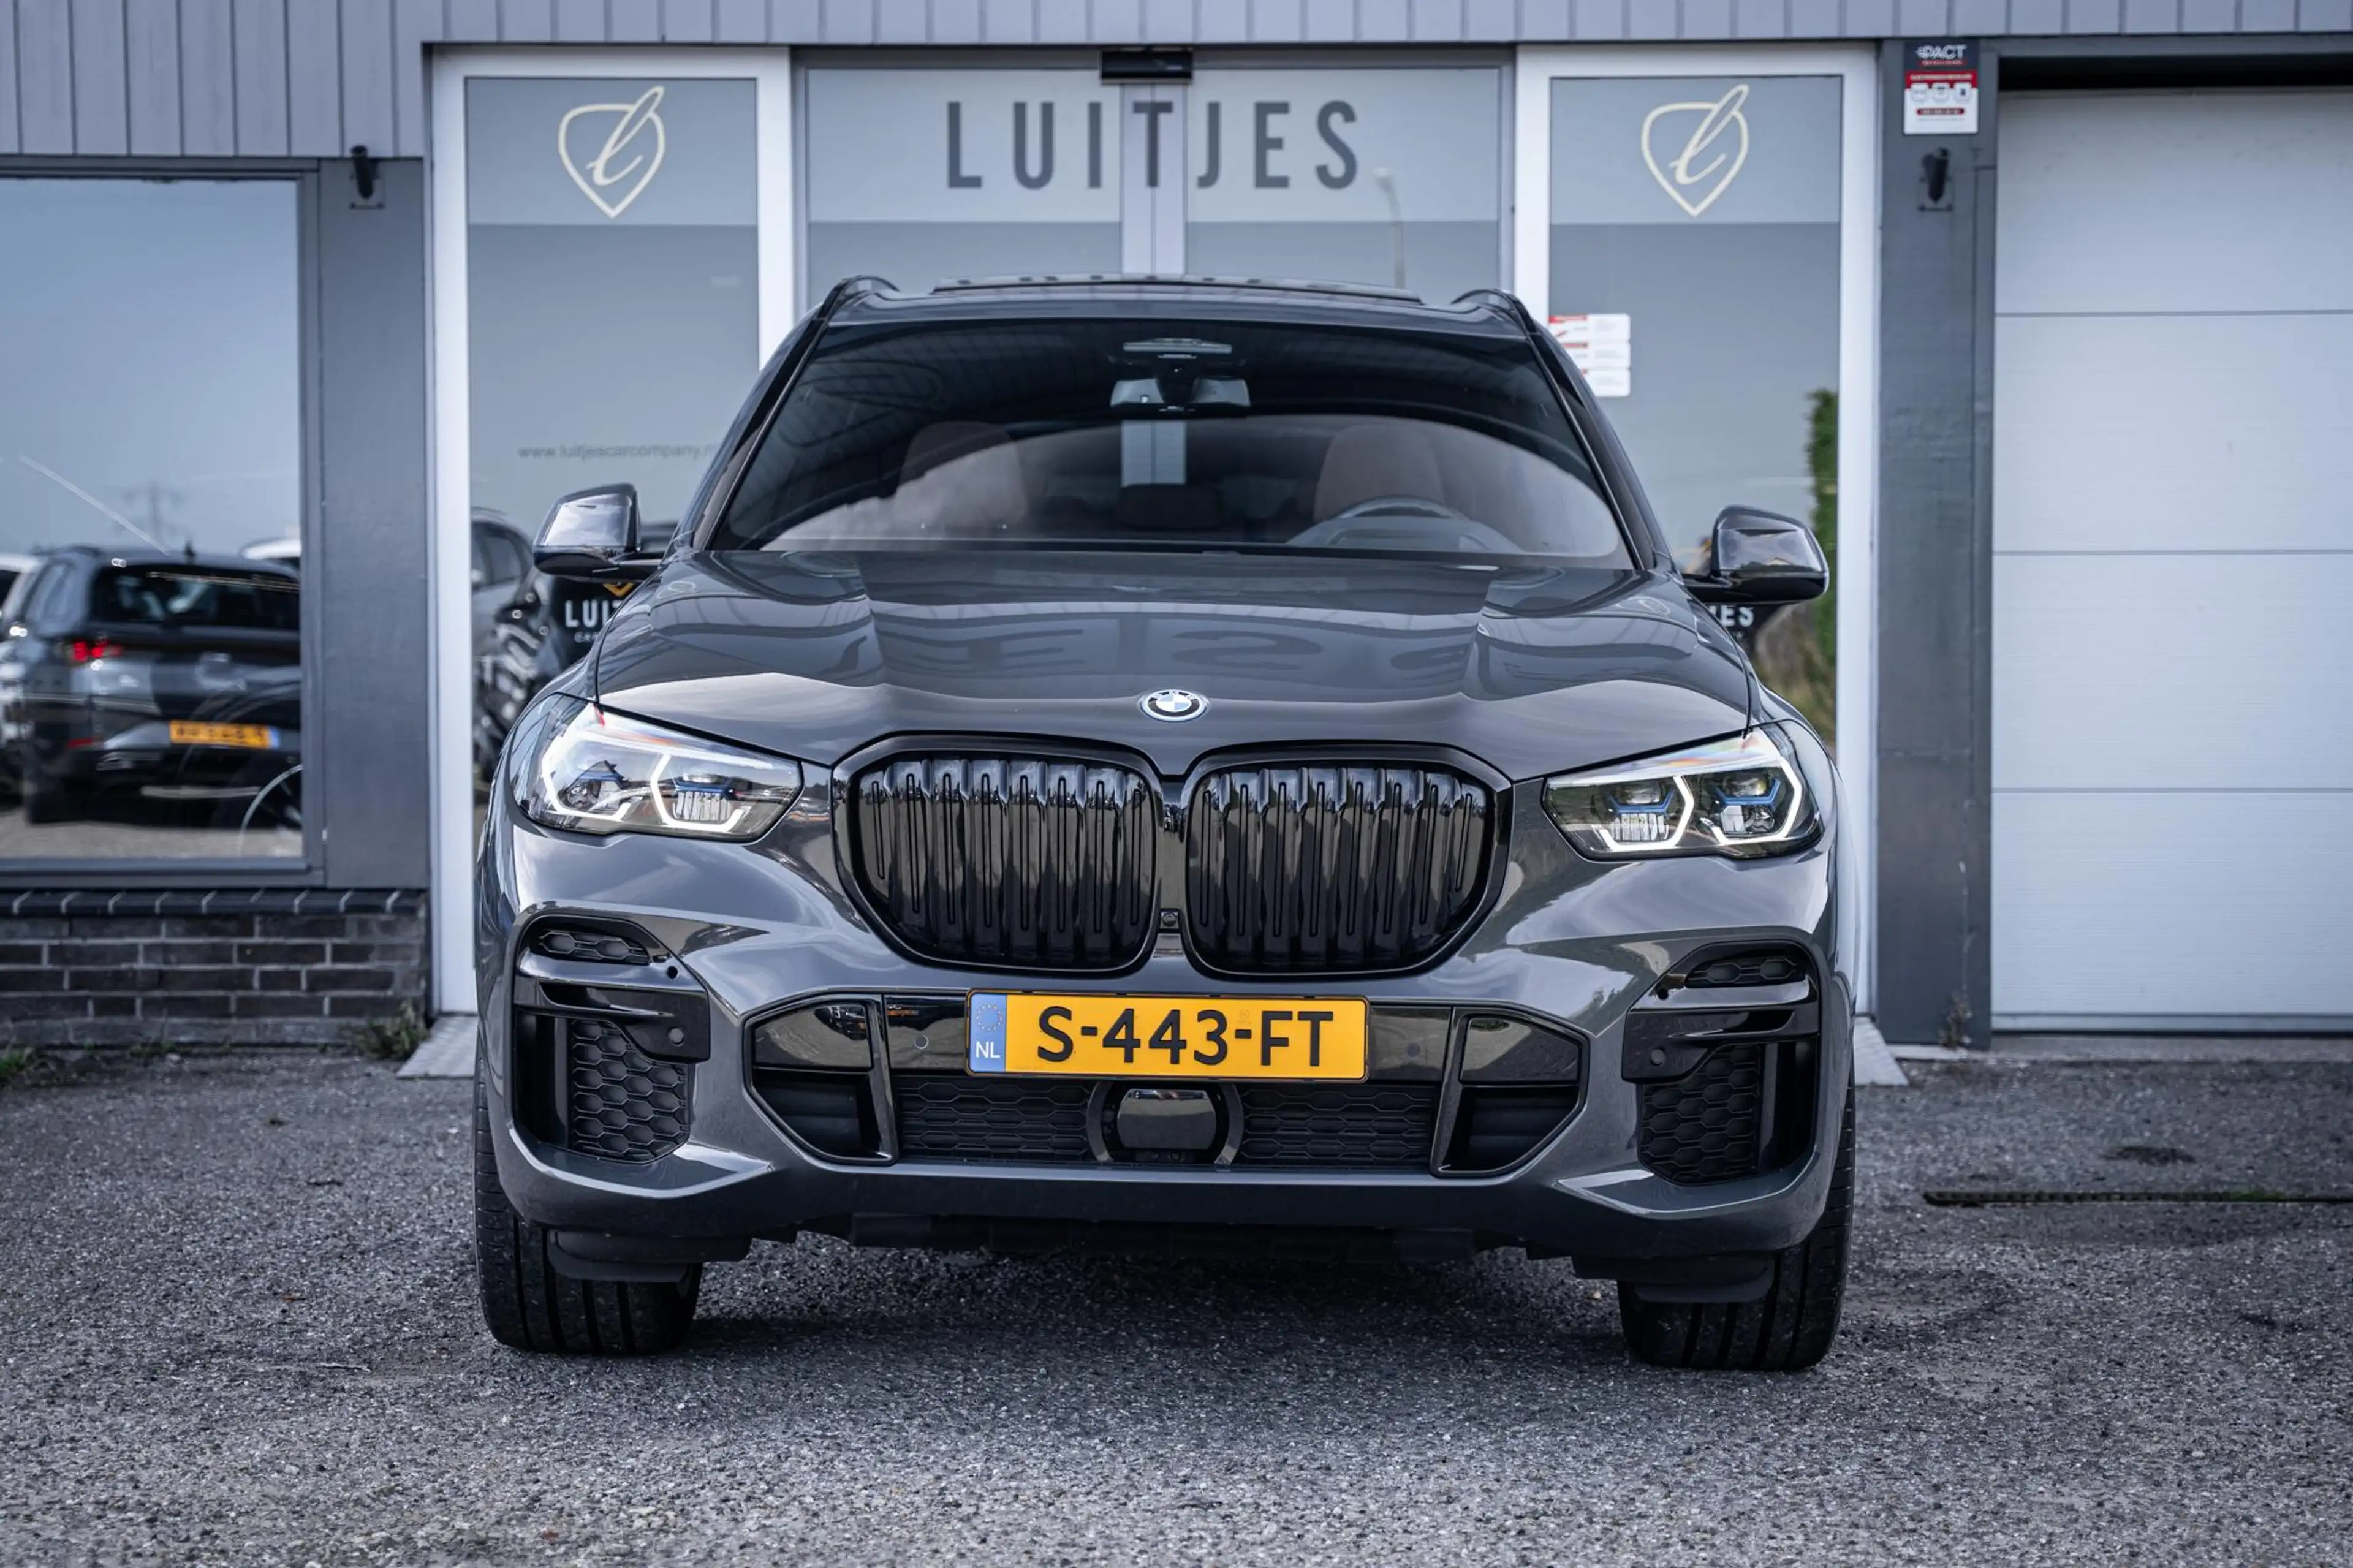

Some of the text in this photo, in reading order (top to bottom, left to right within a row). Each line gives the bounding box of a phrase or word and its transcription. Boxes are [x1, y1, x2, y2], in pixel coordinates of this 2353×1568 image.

[947, 100, 1358, 190] LUITJES
[975, 1040, 1001, 1059] NL
[1037, 1005, 1334, 1067] S-443-FT
